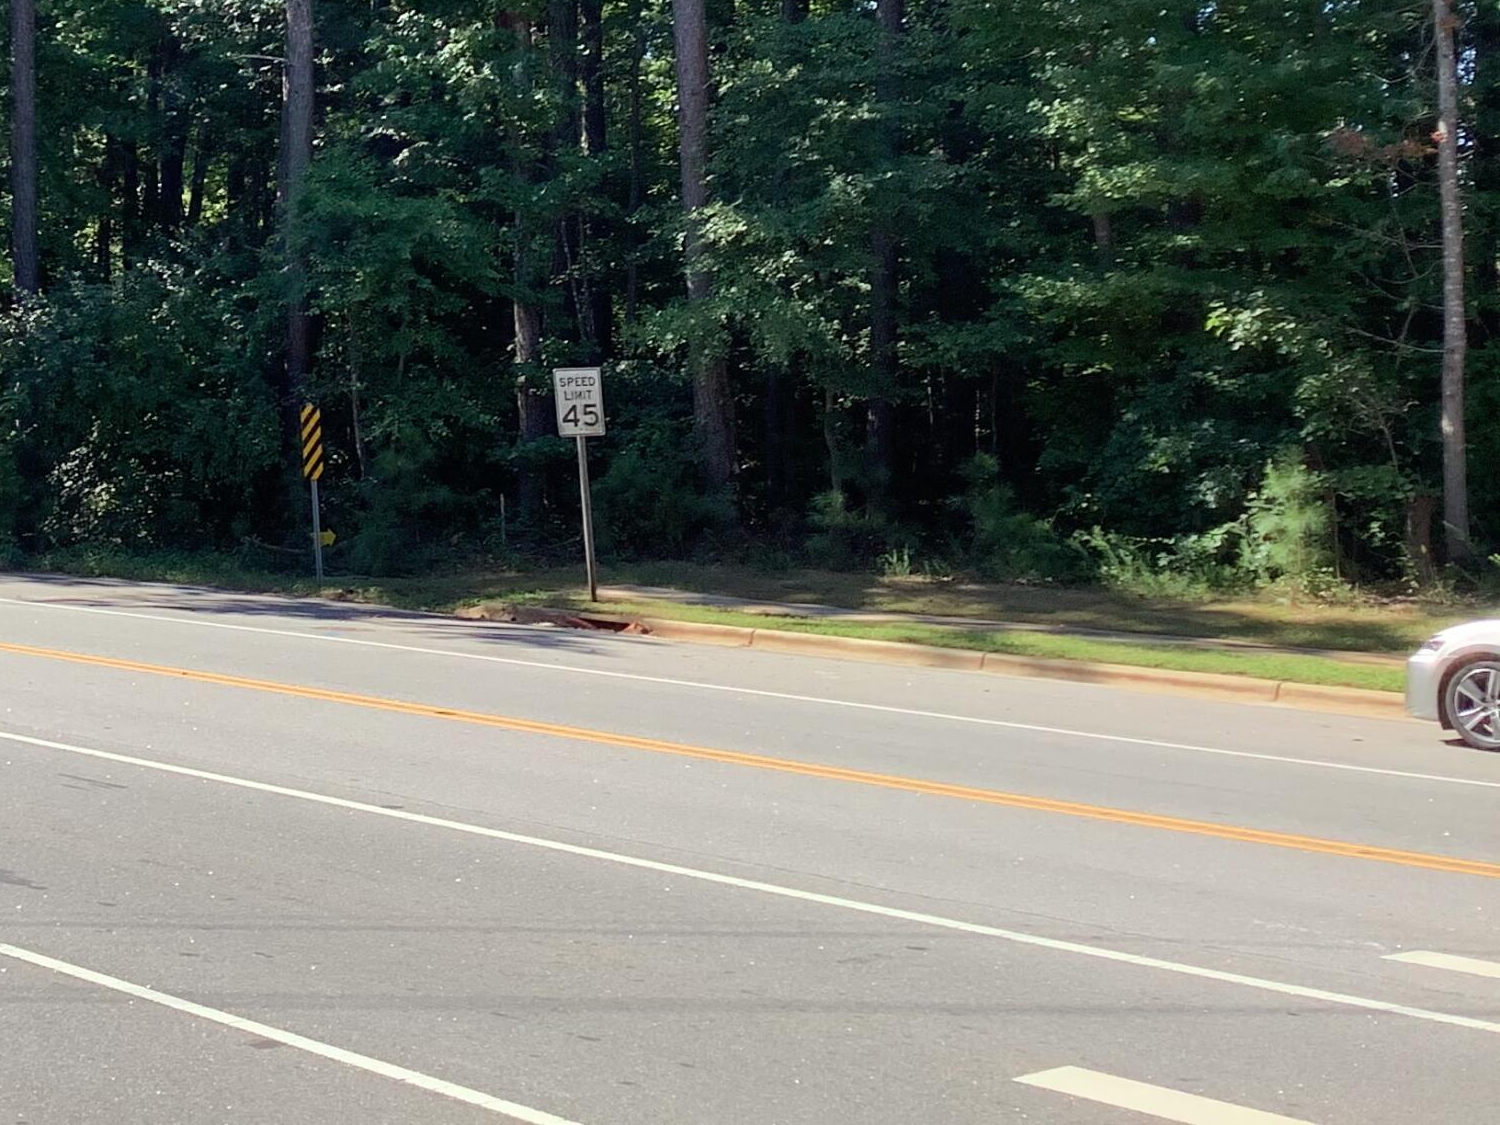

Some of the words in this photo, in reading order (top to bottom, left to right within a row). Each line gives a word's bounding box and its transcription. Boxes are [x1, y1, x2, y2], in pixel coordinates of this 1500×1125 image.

[559, 376, 596, 387] SPEED
[564, 389, 592, 401] LIMIT
[562, 403, 599, 427] 45
